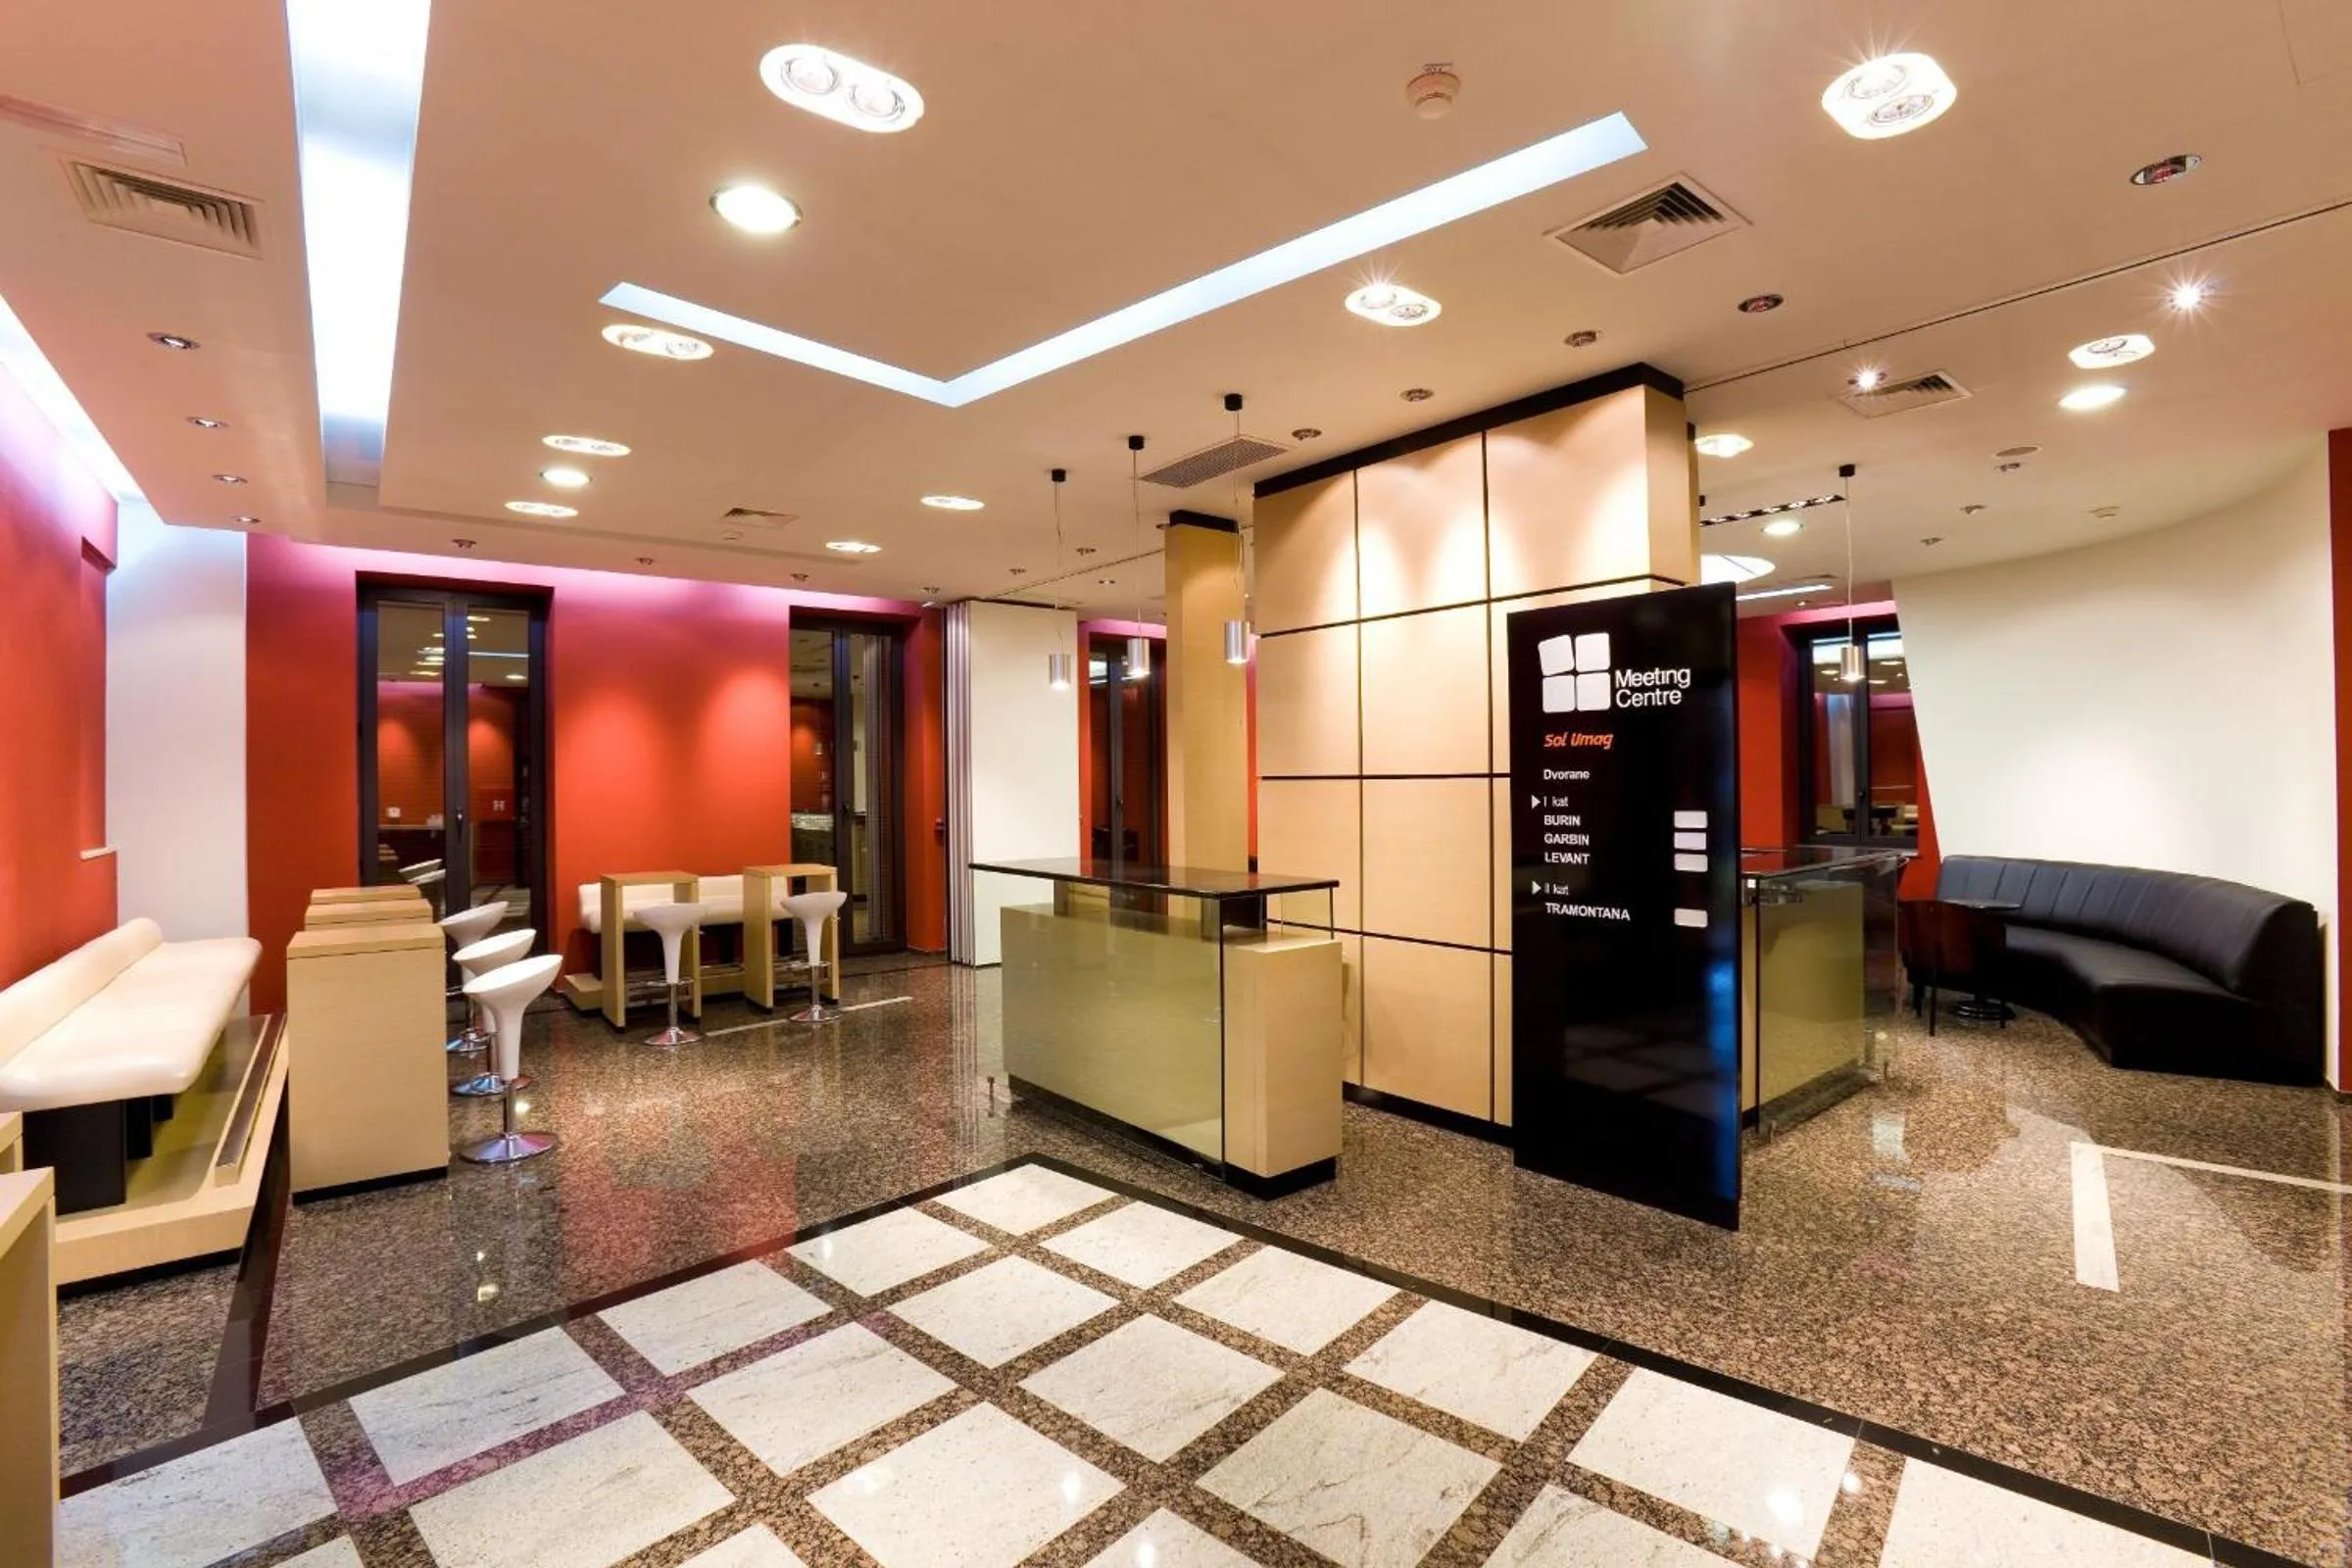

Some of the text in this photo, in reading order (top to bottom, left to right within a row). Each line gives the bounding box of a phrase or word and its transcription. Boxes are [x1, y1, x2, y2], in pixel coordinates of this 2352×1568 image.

[1615, 667, 1691, 689] Meeting
[1616, 688, 1683, 709] Centre
[1544, 732, 1614, 750] Sol Umag
[1544, 768, 1591, 781] Dvorane
[1551, 796, 1569, 808] kat
[1544, 814, 1581, 827] BURIN
[1544, 833, 1590, 846] GARBIN
[1544, 852, 1591, 864] LEVANT
[1552, 883, 1569, 896] kat
[1544, 902, 1631, 921] TRAMONTANA
